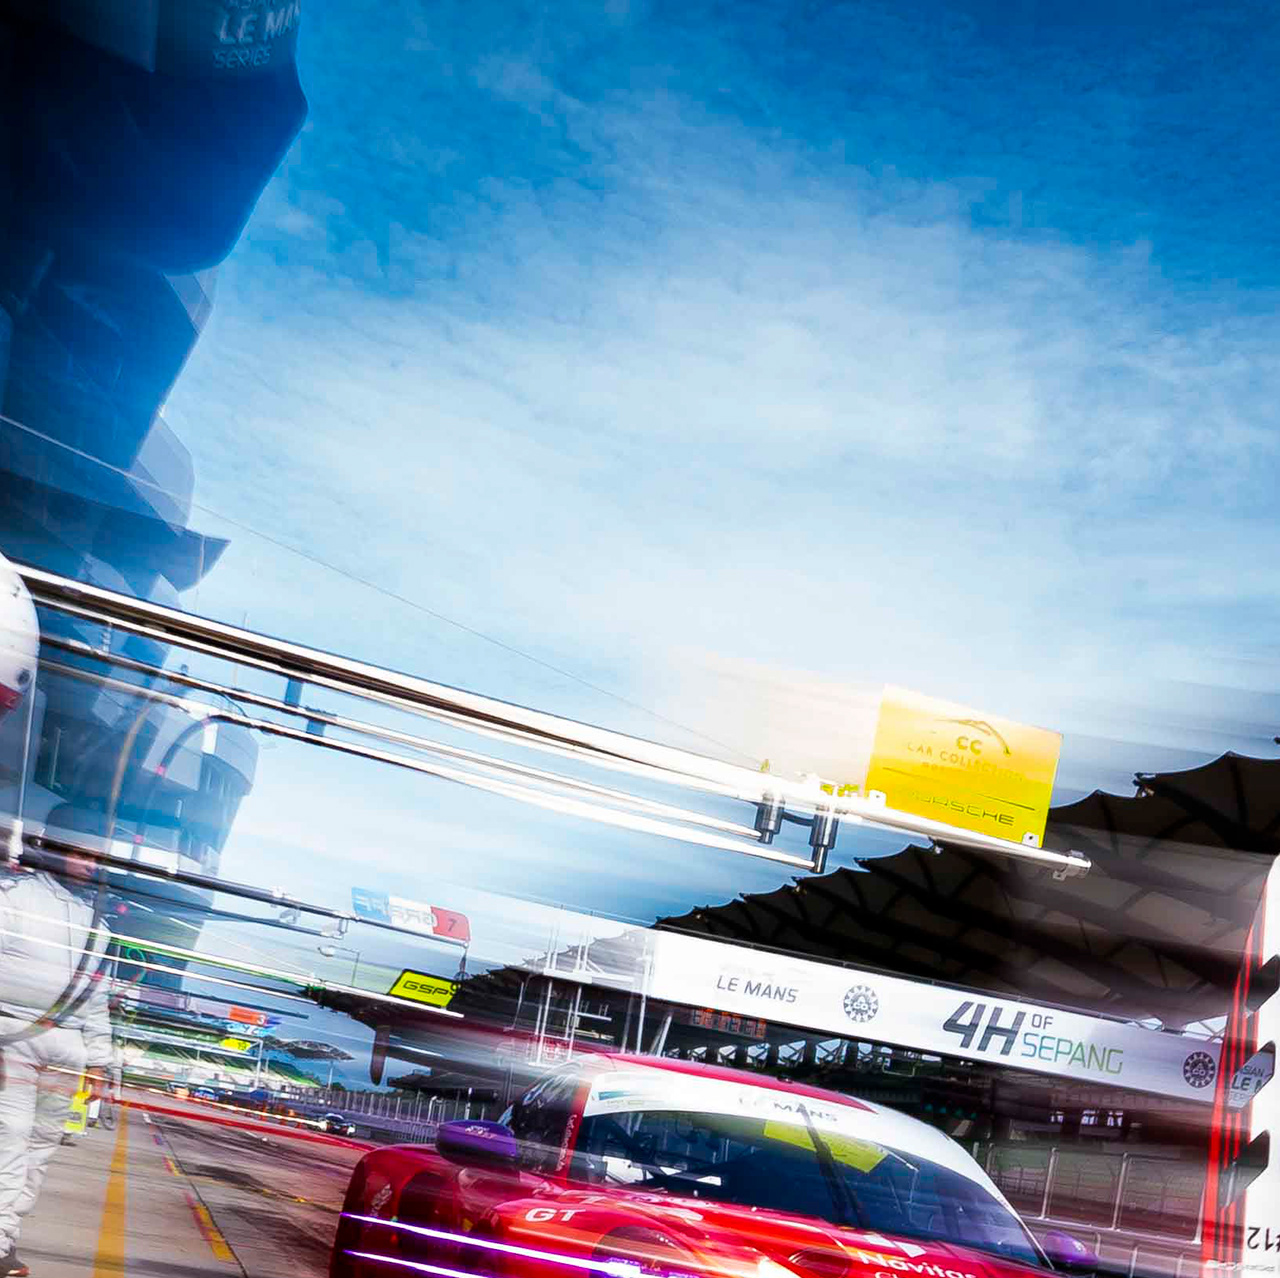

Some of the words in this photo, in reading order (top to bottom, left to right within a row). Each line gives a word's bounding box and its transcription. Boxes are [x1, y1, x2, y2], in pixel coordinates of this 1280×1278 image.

[956, 735, 983, 756] CC
[447, 919, 457, 932] 7
[716, 974, 739, 992] LE
[743, 979, 799, 1004] MANS
[942, 1001, 1027, 1057] 4H
[1031, 1013, 1054, 1030] OF
[1021, 1032, 1124, 1075] SEPANG
[525, 1207, 586, 1223] GT
